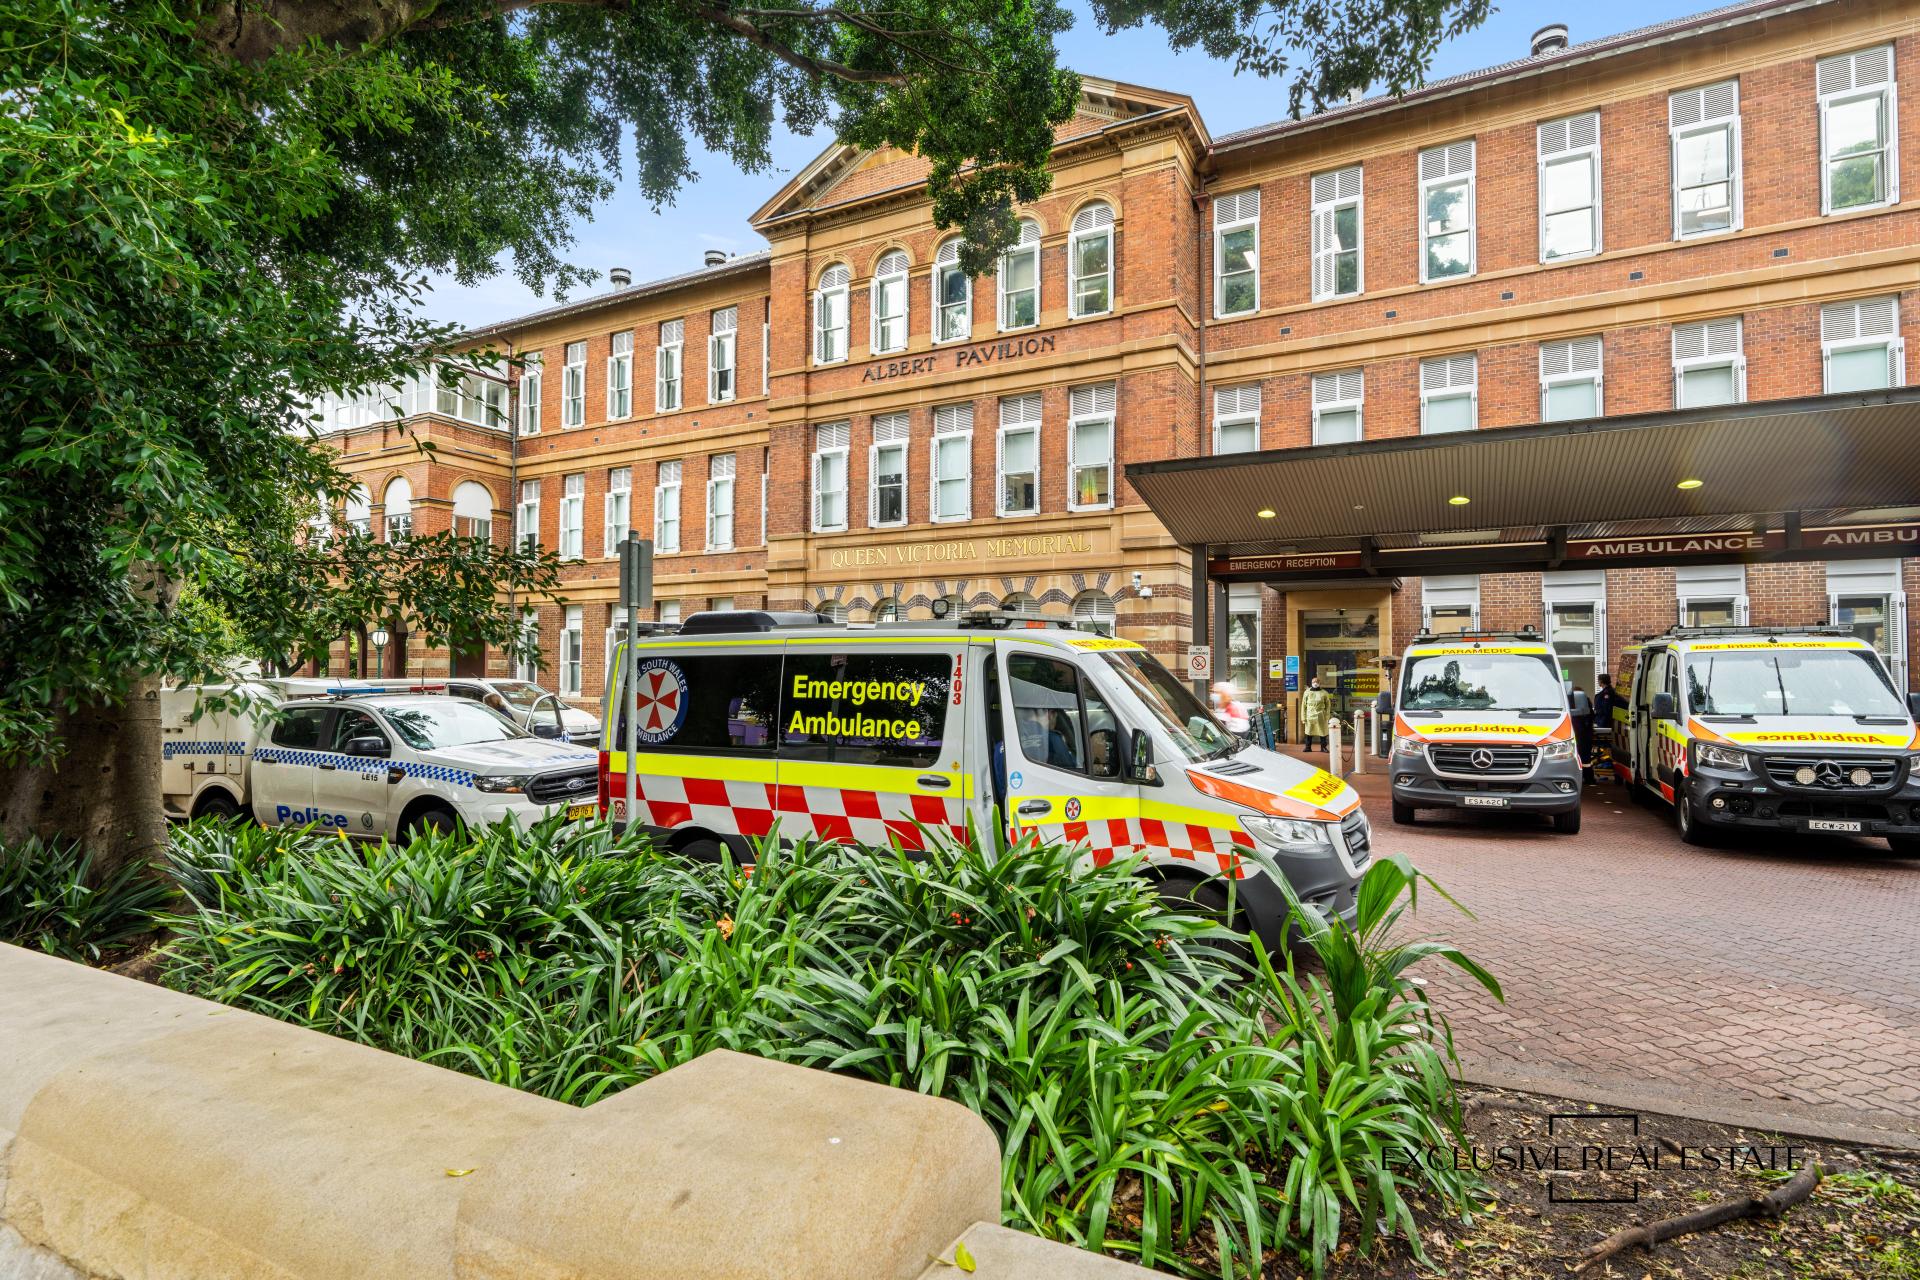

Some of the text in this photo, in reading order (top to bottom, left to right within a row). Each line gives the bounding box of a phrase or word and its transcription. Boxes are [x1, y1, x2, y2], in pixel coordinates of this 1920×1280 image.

[862, 335, 1056, 382] ALBERT PAVILION
[832, 534, 1092, 567] QUEEN VICTORIA MEMORIAL
[1585, 537, 1764, 556] AMBULANCE
[1229, 557, 1336, 571] EMERGENCY RECEPTION
[641, 658, 668, 673] SOUTH
[669, 661, 688, 693] WALES
[793, 674, 925, 707] Emergency
[953, 653, 963, 706] 1403
[637, 723, 679, 743] MBULANCE
[788, 710, 921, 740] Ambulance
[361, 772, 379, 782] LE15
[276, 805, 348, 828] Police
